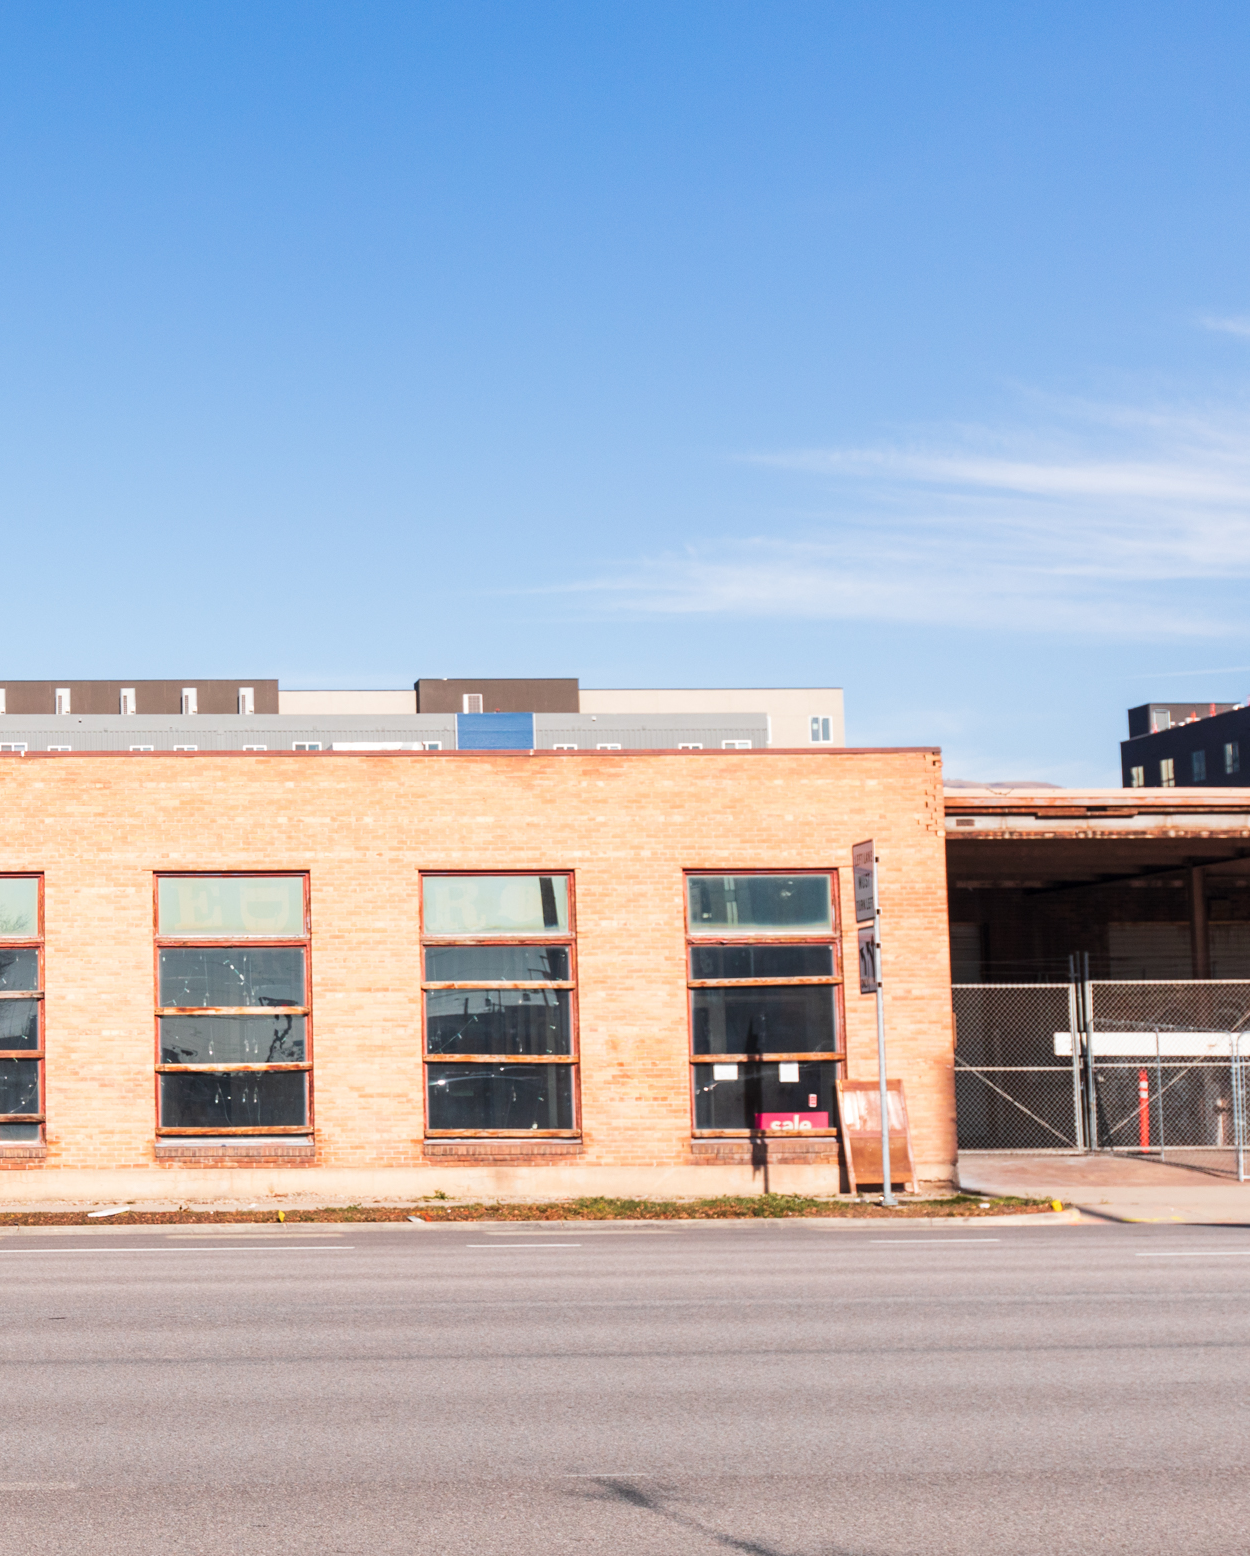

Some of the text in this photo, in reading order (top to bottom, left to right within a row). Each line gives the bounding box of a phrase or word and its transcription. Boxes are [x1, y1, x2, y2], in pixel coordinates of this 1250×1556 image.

[855, 850, 873, 867] LEFT LANE
[858, 872, 871, 889] MUST
[770, 1114, 812, 1130] sale
